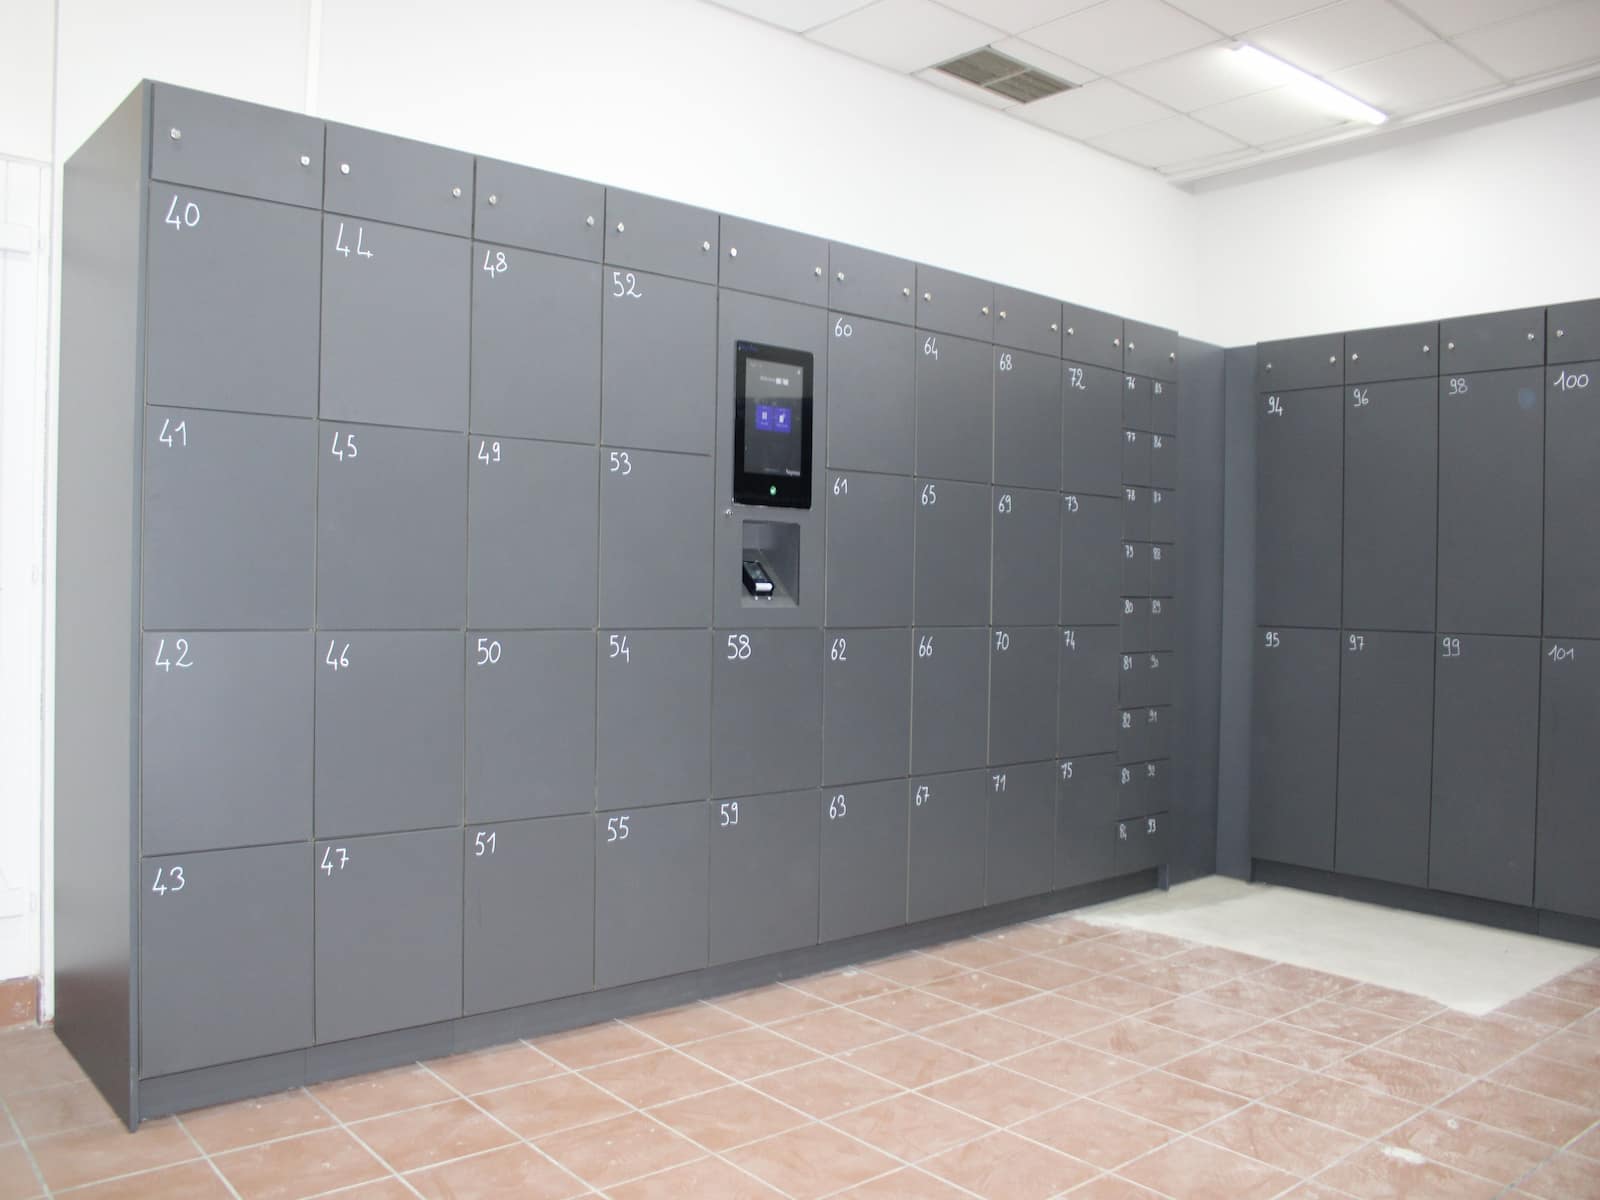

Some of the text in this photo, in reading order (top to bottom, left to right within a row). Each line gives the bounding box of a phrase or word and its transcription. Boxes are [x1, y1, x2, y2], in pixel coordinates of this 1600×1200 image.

[165, 195, 200, 230] 40
[484, 250, 507, 278] 48
[614, 272, 642, 298] 52
[835, 318, 853, 336] 60
[924, 337, 939, 360] 64
[1000, 353, 1013, 371] 68
[1069, 368, 1086, 389] 72
[1126, 377, 1136, 390] 76
[1449, 378, 1469, 395] 98
[1554, 371, 1590, 391] 100
[1268, 396, 1284, 416] 94
[1354, 389, 1369, 407] 96
[160, 419, 186, 447] 41
[332, 432, 357, 461] 45
[478, 441, 500, 464] 49
[611, 452, 631, 475] 53
[834, 478, 848, 495] 61
[922, 484, 937, 505] 65
[1126, 489, 1136, 502] 78
[999, 495, 1012, 513] 69
[1065, 496, 1079, 512] 73
[1125, 600, 1134, 615] 80
[610, 635, 629, 662] 54
[728, 635, 751, 659] 58
[831, 639, 847, 660] 62
[919, 636, 934, 657] 66
[996, 631, 1010, 650] 70
[1064, 630, 1076, 650] 74
[1266, 632, 1281, 647] 95
[1350, 634, 1365, 650] 97
[1443, 637, 1461, 656] 99
[155, 639, 193, 672] 42
[326, 640, 349, 670] 46
[478, 638, 501, 664] 50
[1548, 645, 1575, 661] 101
[1123, 656, 1133, 671] 81
[1061, 762, 1073, 779] 75
[993, 774, 1007, 791] 71
[916, 786, 930, 806] 67
[721, 802, 738, 826] 59
[830, 795, 847, 819] 63
[608, 816, 629, 842] 55
[476, 832, 495, 855] 51
[321, 847, 349, 876] 47
[152, 867, 185, 895] 43
